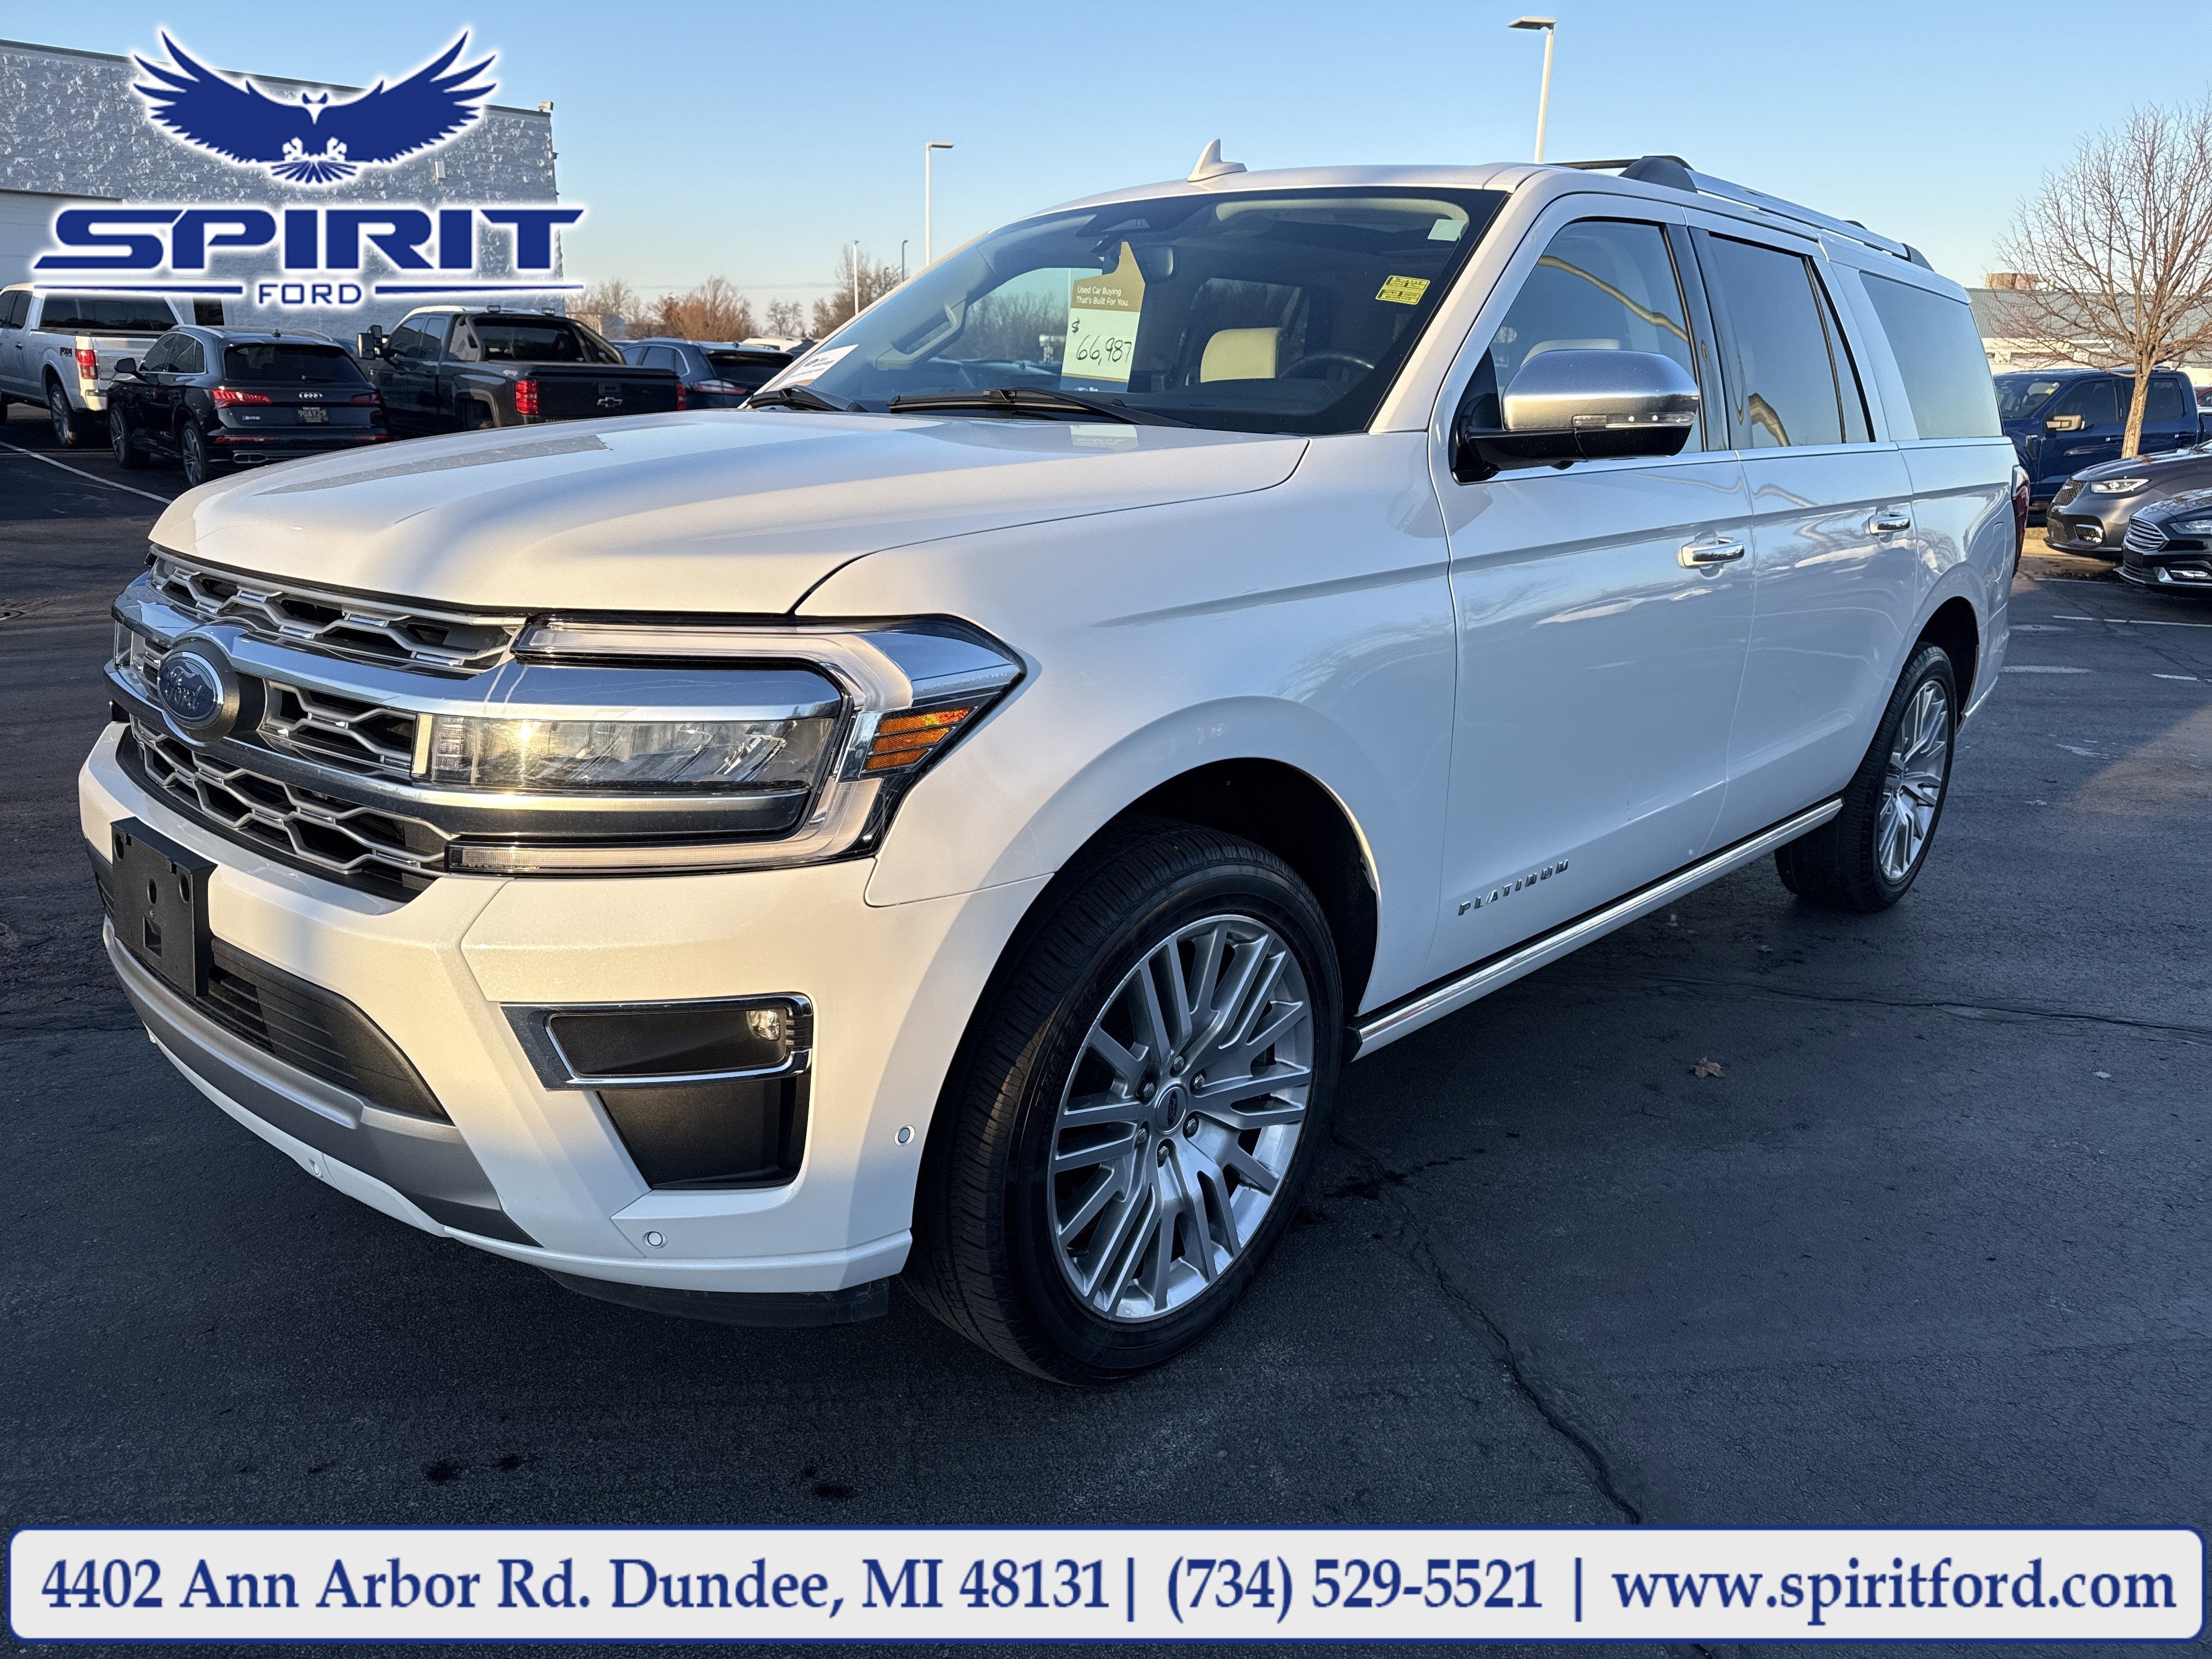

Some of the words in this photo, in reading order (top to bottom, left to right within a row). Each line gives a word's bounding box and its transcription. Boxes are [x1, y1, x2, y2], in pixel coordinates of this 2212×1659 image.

[1076, 296, 1092, 304] That's
[1093, 296, 1105, 305] Built
[1107, 297, 1116, 306] For
[1117, 298, 1128, 306] You.
[1077, 286, 1091, 294] Used
[1102, 287, 1121, 297] Buying
[1076, 335, 1132, 366] 66,987
[923, 672, 1008, 691] EXPEDITION
[1458, 859, 1569, 916] PLATINUM
